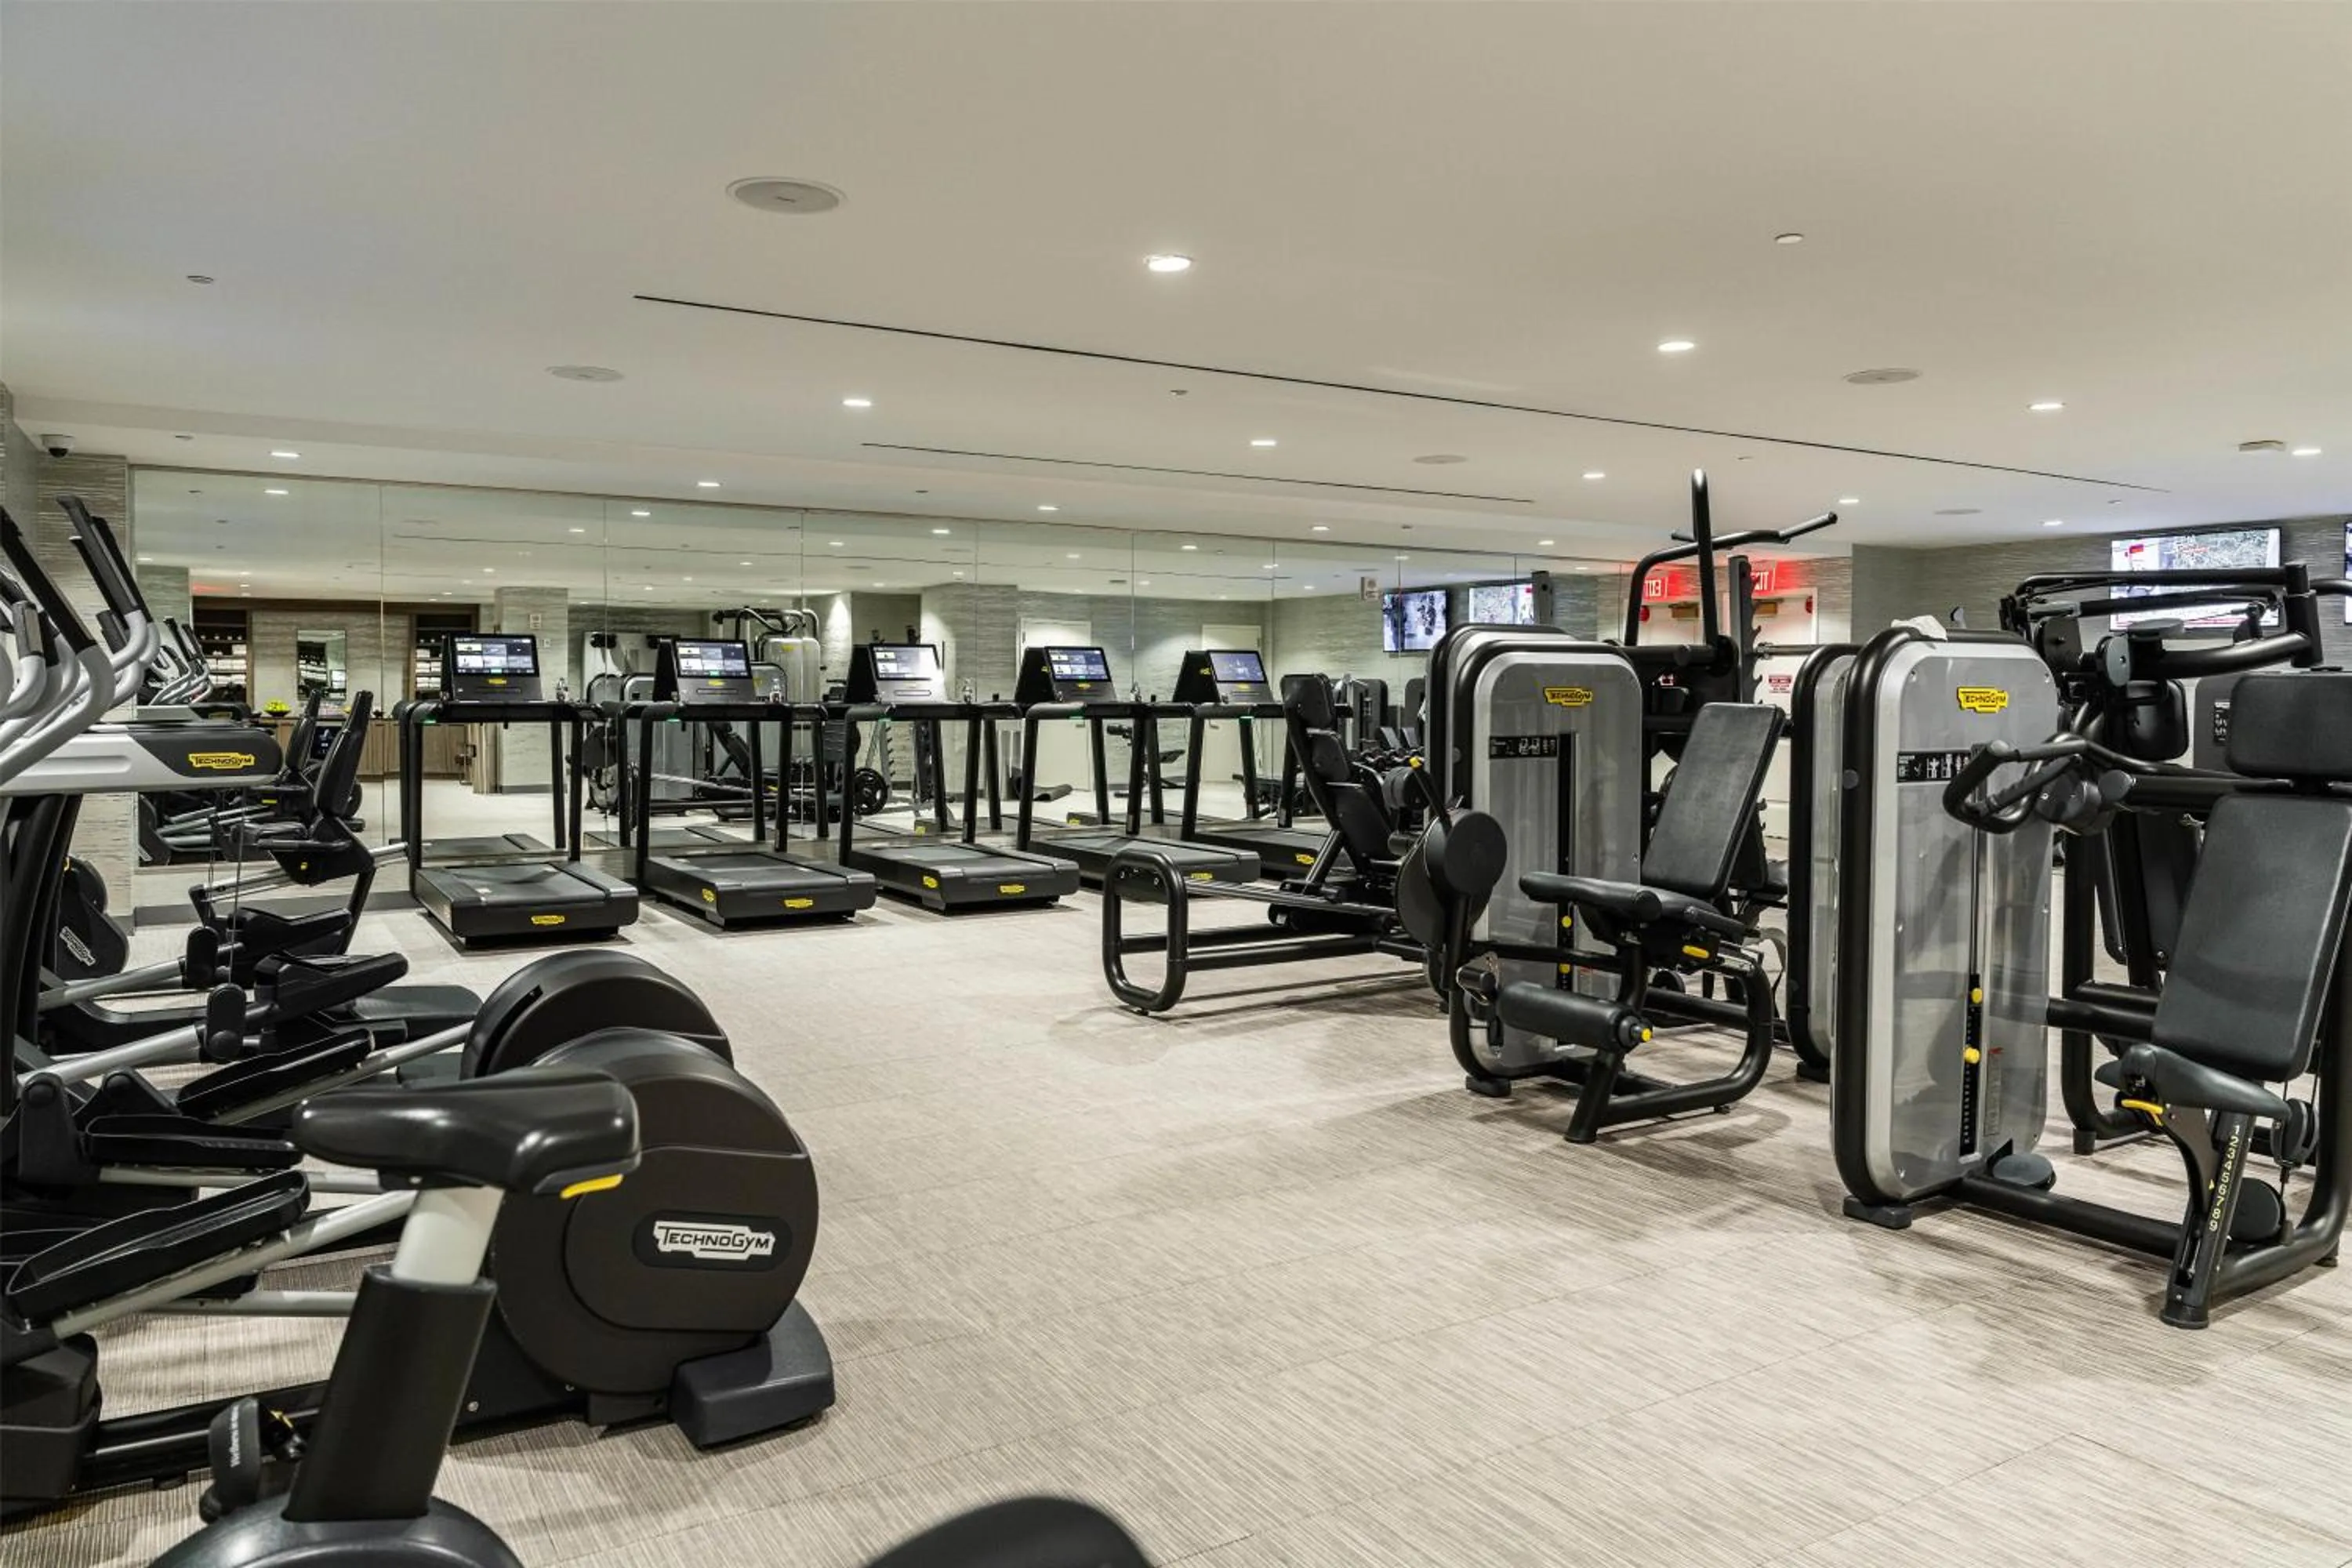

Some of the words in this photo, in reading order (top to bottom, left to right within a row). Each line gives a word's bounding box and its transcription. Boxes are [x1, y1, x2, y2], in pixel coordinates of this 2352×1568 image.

[1960, 691, 2006, 708] TECHNOGYM
[191, 755, 252, 767] TECHNOGYM
[2234, 1125, 2240, 1134] 1
[2230, 1136, 2239, 1147] 2
[2227, 1148, 2236, 1159] 3
[2224, 1160, 2232, 1171] 4
[2221, 1172, 2230, 1183] 5
[2219, 1184, 2227, 1195] 6
[2216, 1196, 2224, 1207] 7
[2212, 1208, 2221, 1219] 8
[2209, 1220, 2218, 1232] 9
[658, 1225, 770, 1253] TECHNOGYM
